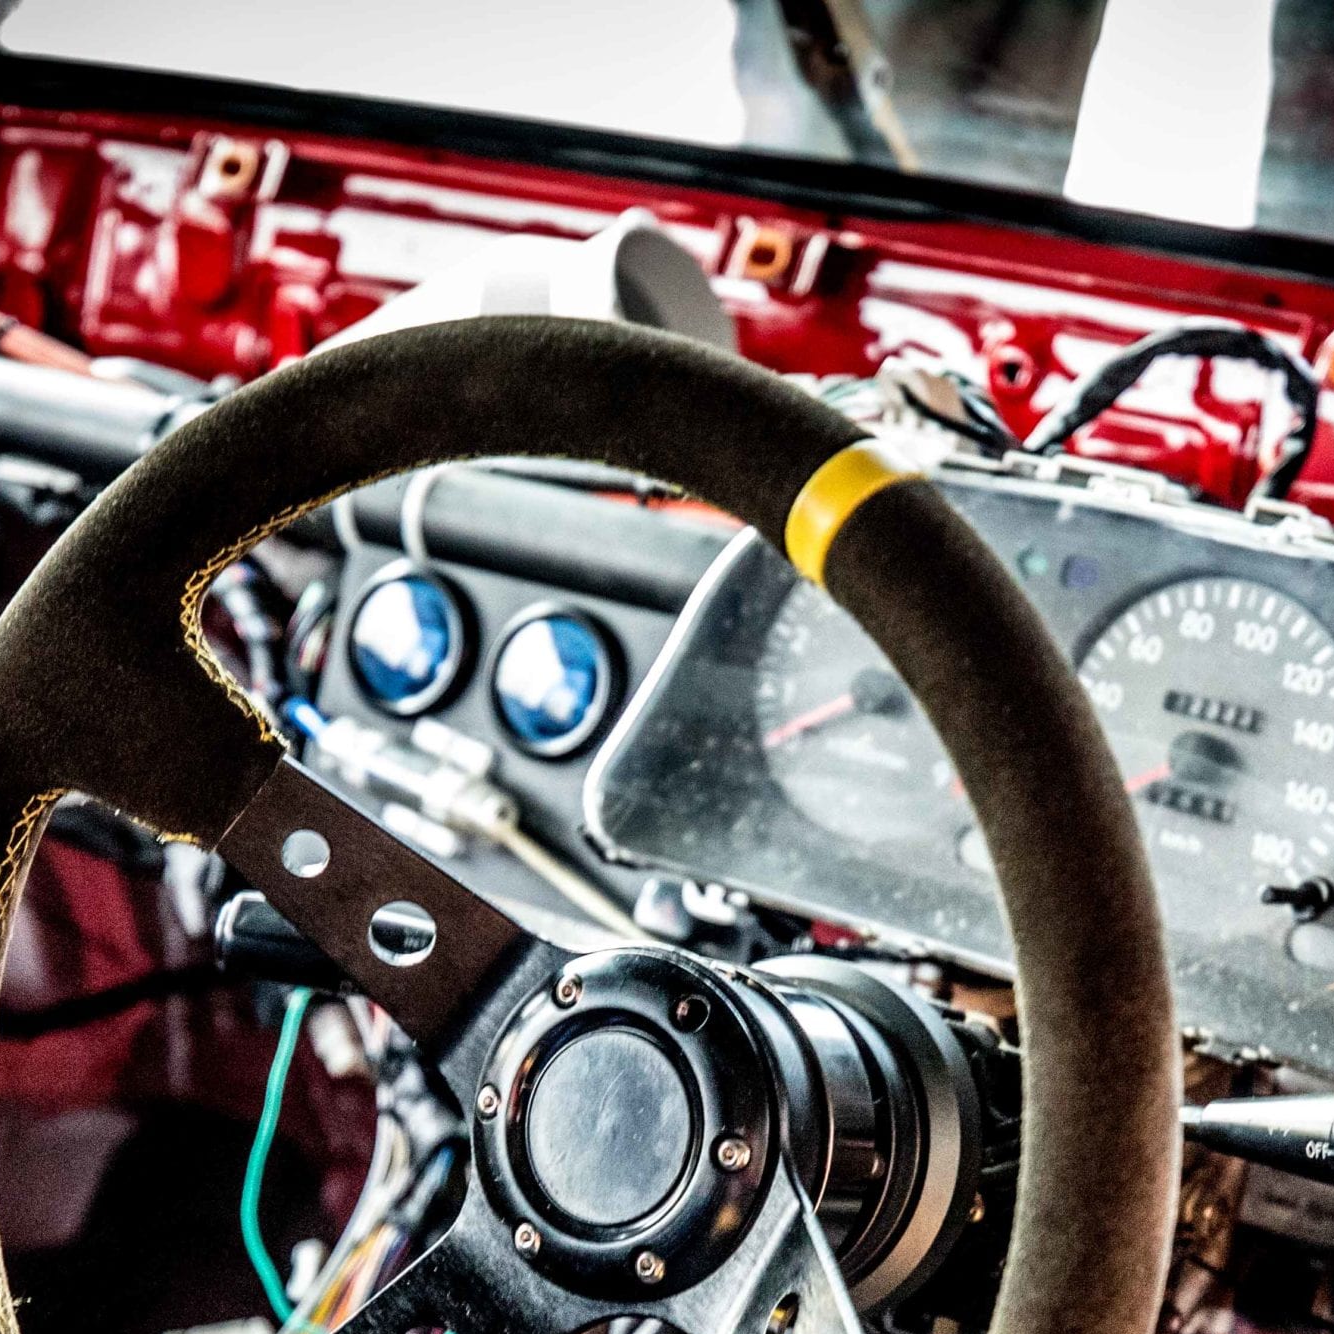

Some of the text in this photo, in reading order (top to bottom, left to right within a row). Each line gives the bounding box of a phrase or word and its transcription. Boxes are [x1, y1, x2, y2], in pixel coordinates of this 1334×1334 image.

[1178, 609, 1214, 641] 80
[1234, 620, 1278, 655] 100
[1283, 662, 1324, 696] 120
[1305, 1139, 1330, 1160] OFF
